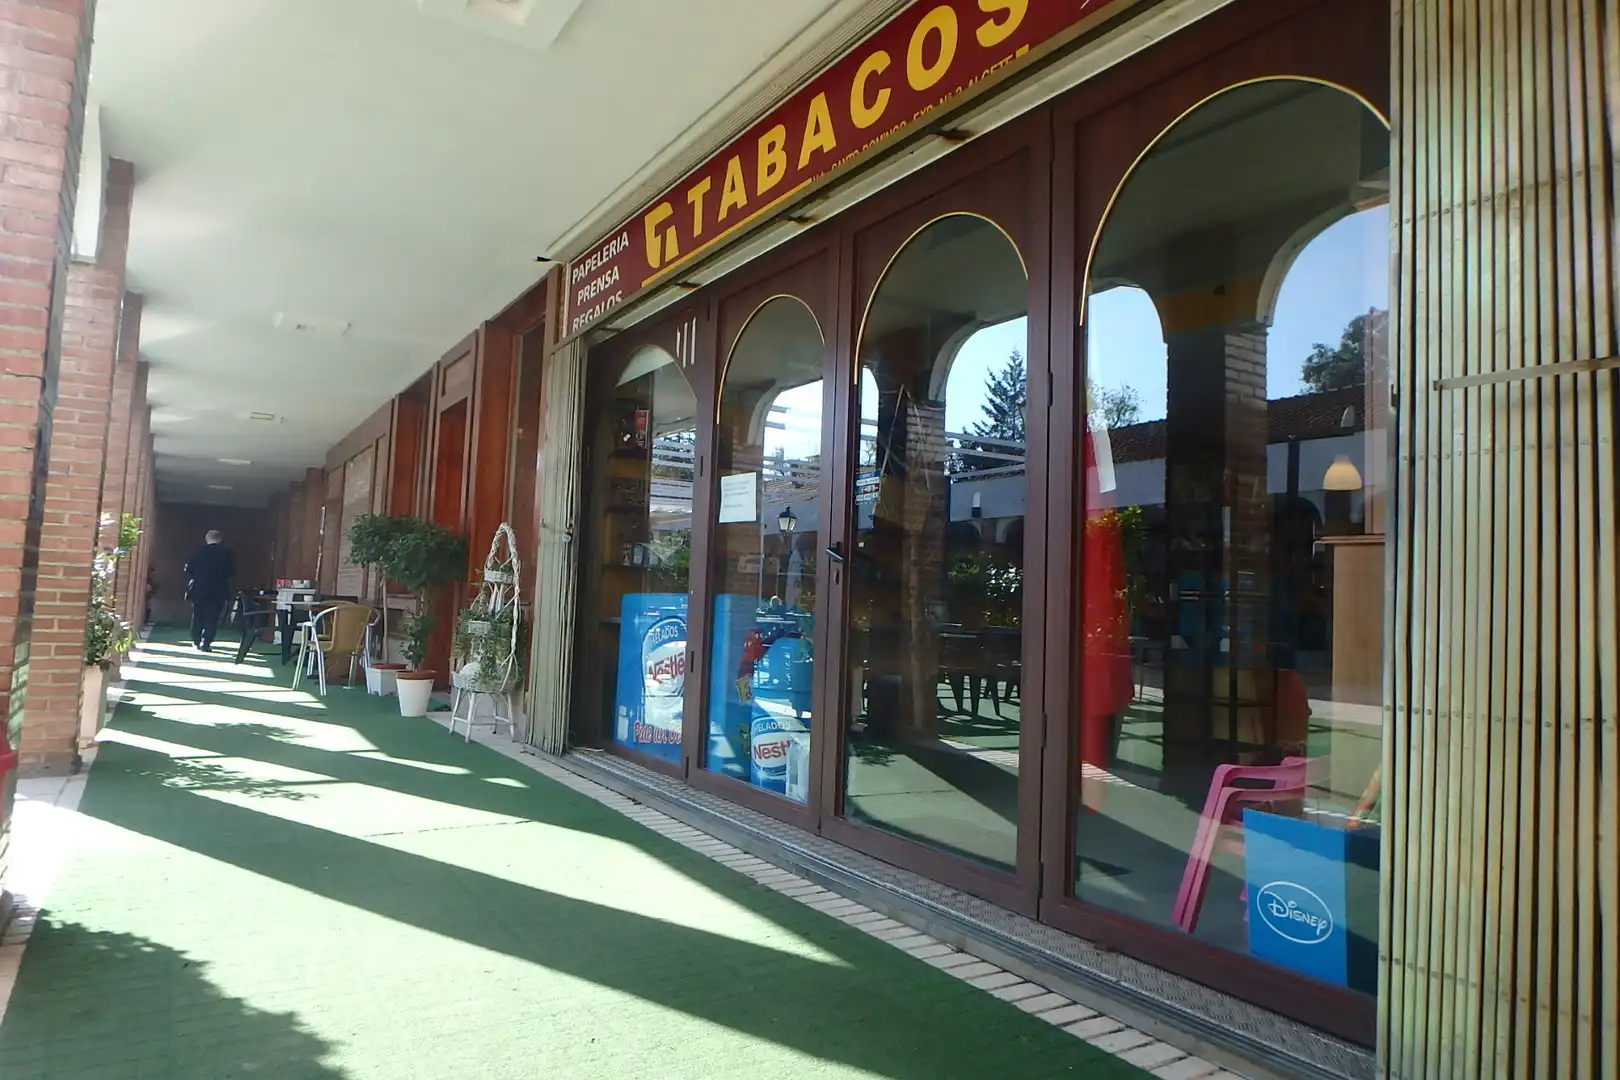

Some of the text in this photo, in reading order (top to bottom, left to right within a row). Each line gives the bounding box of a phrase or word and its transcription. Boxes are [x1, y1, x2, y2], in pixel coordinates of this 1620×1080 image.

[687, 0, 1029, 238] TABACOS
[572, 231, 630, 285] PAPELERIA
[577, 265, 620, 306] PRENSA
[572, 290, 623, 333] REGALOS
